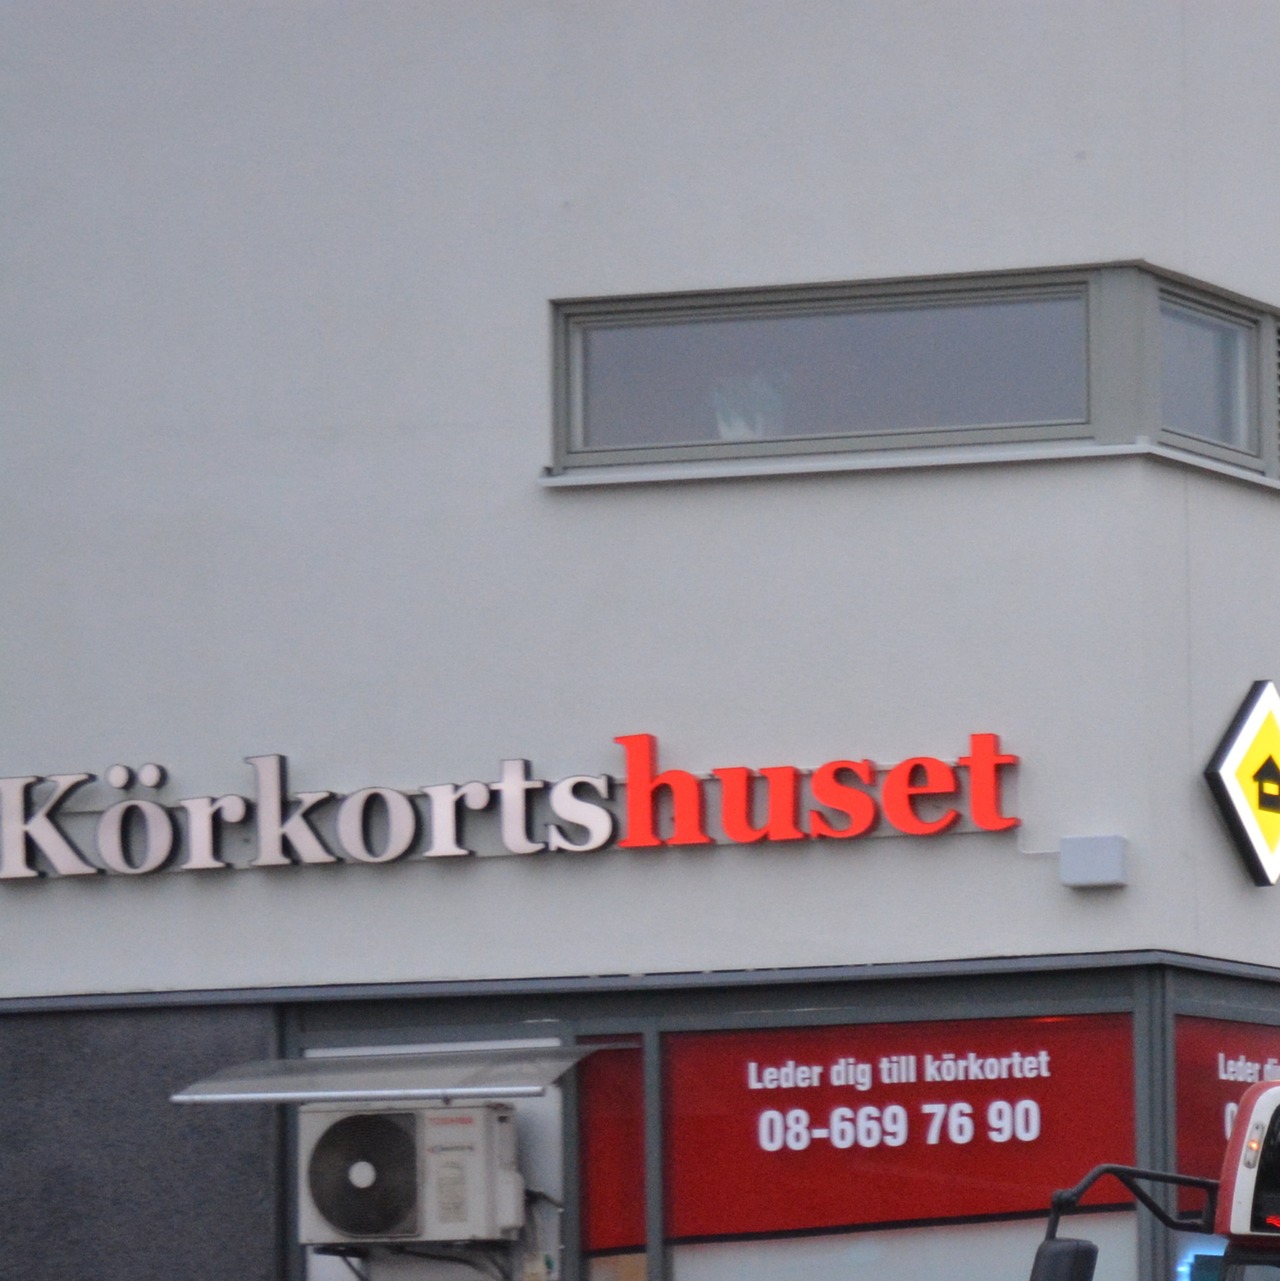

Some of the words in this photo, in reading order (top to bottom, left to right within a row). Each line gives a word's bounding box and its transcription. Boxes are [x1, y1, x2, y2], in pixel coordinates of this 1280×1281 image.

[0, 733, 1021, 878] Körkortshuset
[748, 1062, 823, 1090] Leder
[830, 1058, 872, 1091] dig
[879, 1055, 917, 1084] till
[924, 1051, 1051, 1082] körkortet
[1217, 1053, 1261, 1083] Leder
[758, 1105, 908, 1152] 08-669
[921, 1102, 974, 1145] 76
[987, 1099, 1042, 1142] 90
